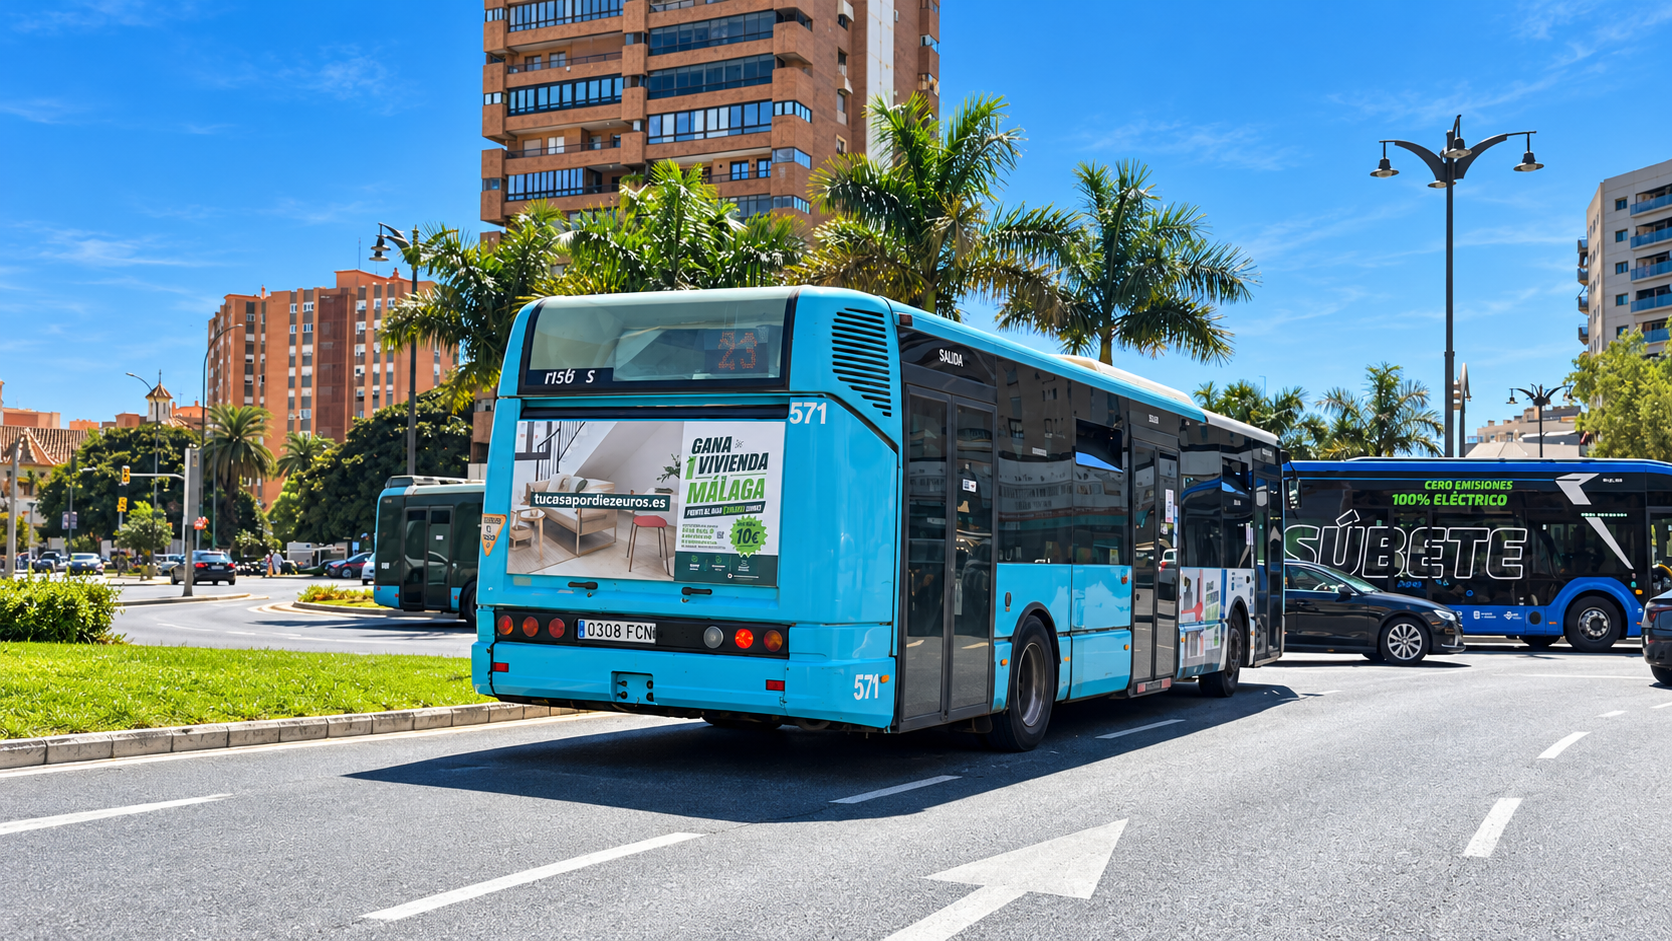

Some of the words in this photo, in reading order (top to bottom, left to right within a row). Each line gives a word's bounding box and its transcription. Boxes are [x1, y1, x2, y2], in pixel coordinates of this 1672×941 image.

[938, 349, 964, 367] SALIDA
[789, 402, 827, 424] 571
[691, 436, 733, 454] GANA
[685, 456, 697, 480] 1
[698, 452, 769, 474] VIVIENDA
[686, 475, 765, 504] MÁLAGA
[1424, 481, 1453, 490] CERO
[1454, 480, 1513, 490] EMISIONES
[533, 493, 666, 508] tucasapordiezeuros.es
[1392, 493, 1431, 506] 100%
[1433, 491, 1508, 506] ELÉCTRICO
[736, 528, 760, 545] 10€
[1284, 509, 1528, 580] SÚBETE
[588, 622, 621, 638] 0308
[853, 673, 879, 700] 571
